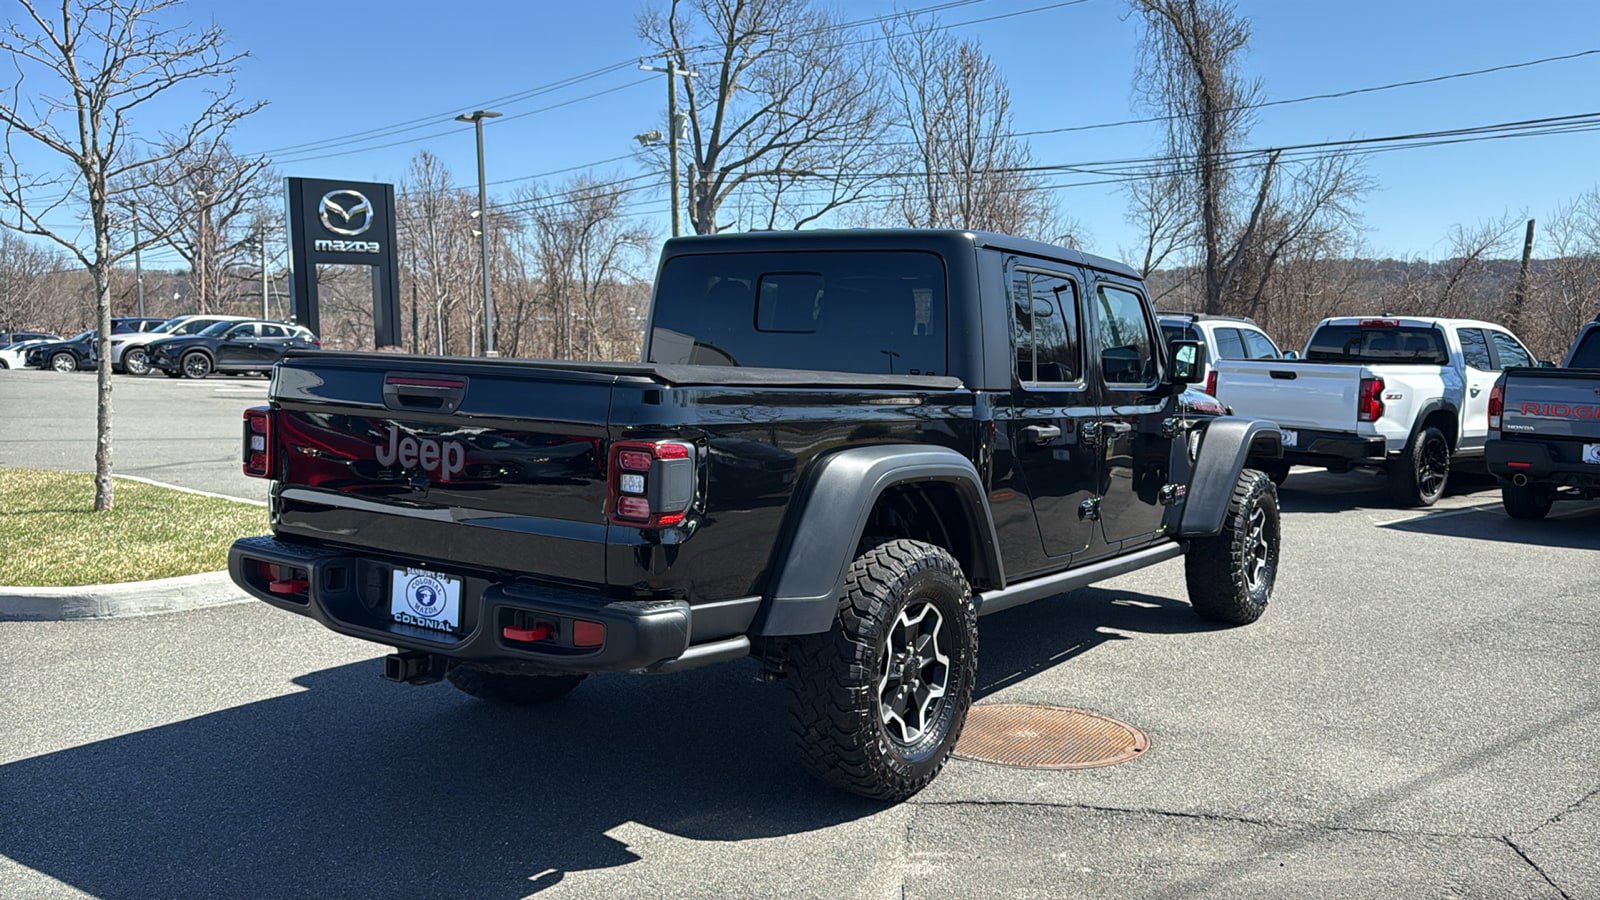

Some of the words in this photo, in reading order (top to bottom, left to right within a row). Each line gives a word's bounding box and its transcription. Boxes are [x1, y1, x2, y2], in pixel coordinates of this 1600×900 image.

[1520, 402, 1600, 419] RIDG
[375, 425, 465, 481] Jeep
[411, 578, 442, 596] COLONIAL
[414, 602, 438, 614] MAZDA
[394, 613, 453, 632] COLONIAL
